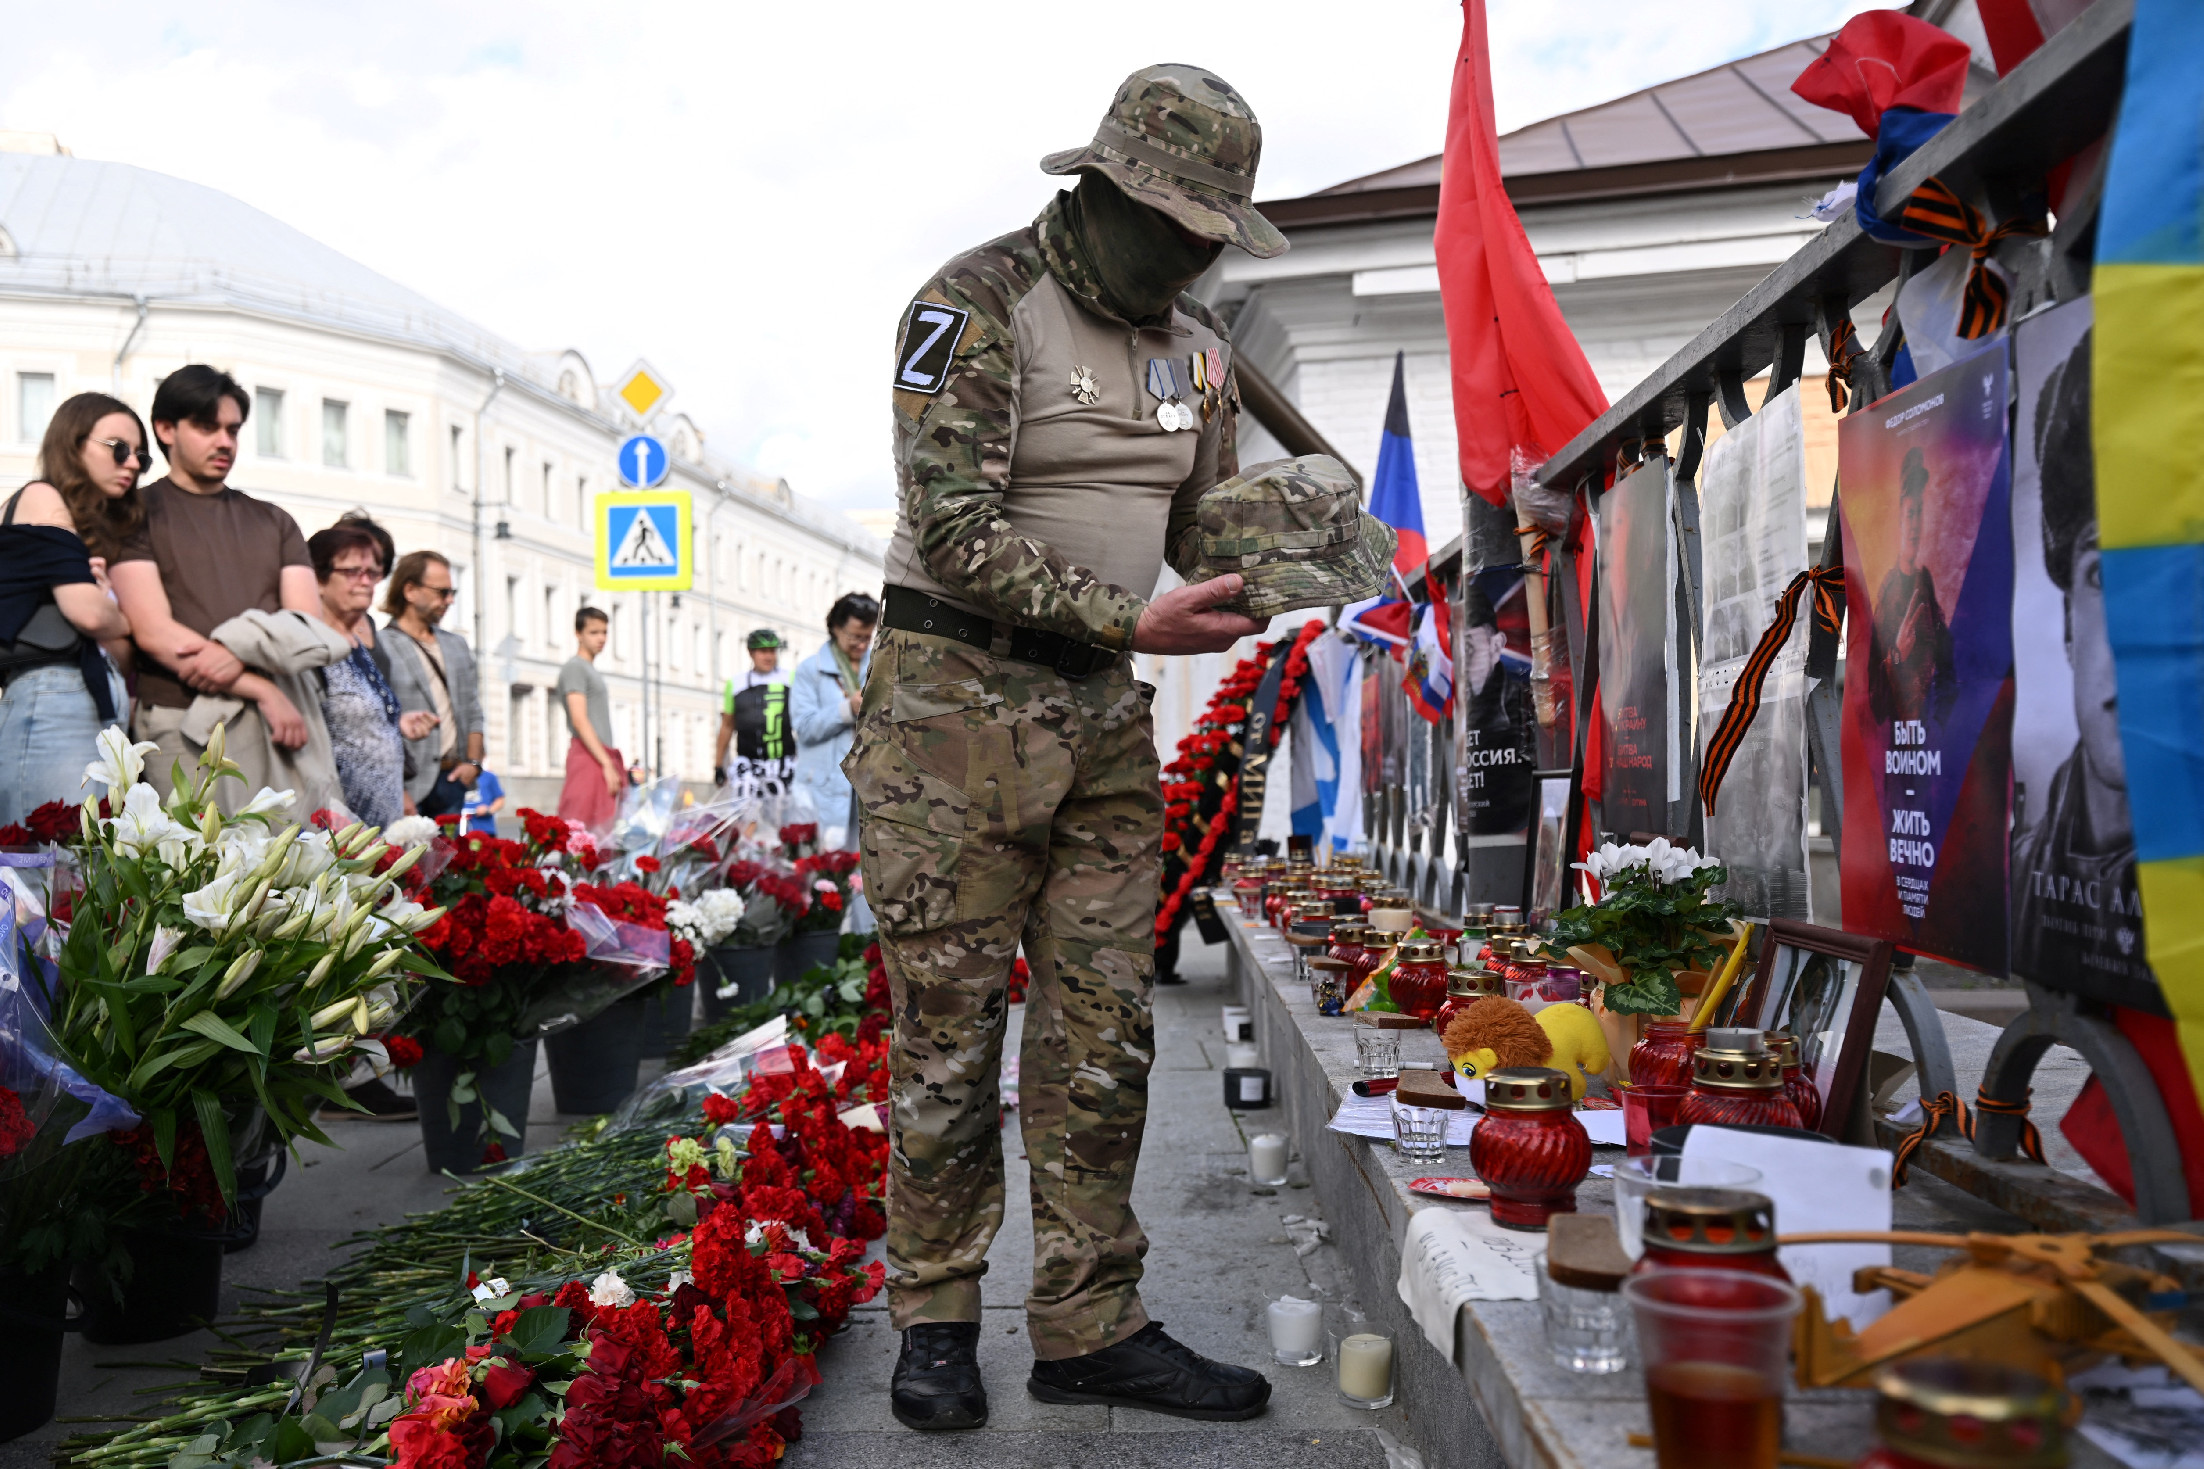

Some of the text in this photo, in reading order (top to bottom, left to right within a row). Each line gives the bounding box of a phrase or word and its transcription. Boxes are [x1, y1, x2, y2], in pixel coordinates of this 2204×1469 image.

[901, 310, 955, 386] Z
[1894, 719, 1927, 745] БЫТЬ
[1885, 750, 1942, 776] ВОИНОМ
[1891, 809, 1931, 837] ЖИТЬ
[1889, 838, 1936, 868] ВЕЧНО
[2032, 870, 2101, 909] ТАРАС
